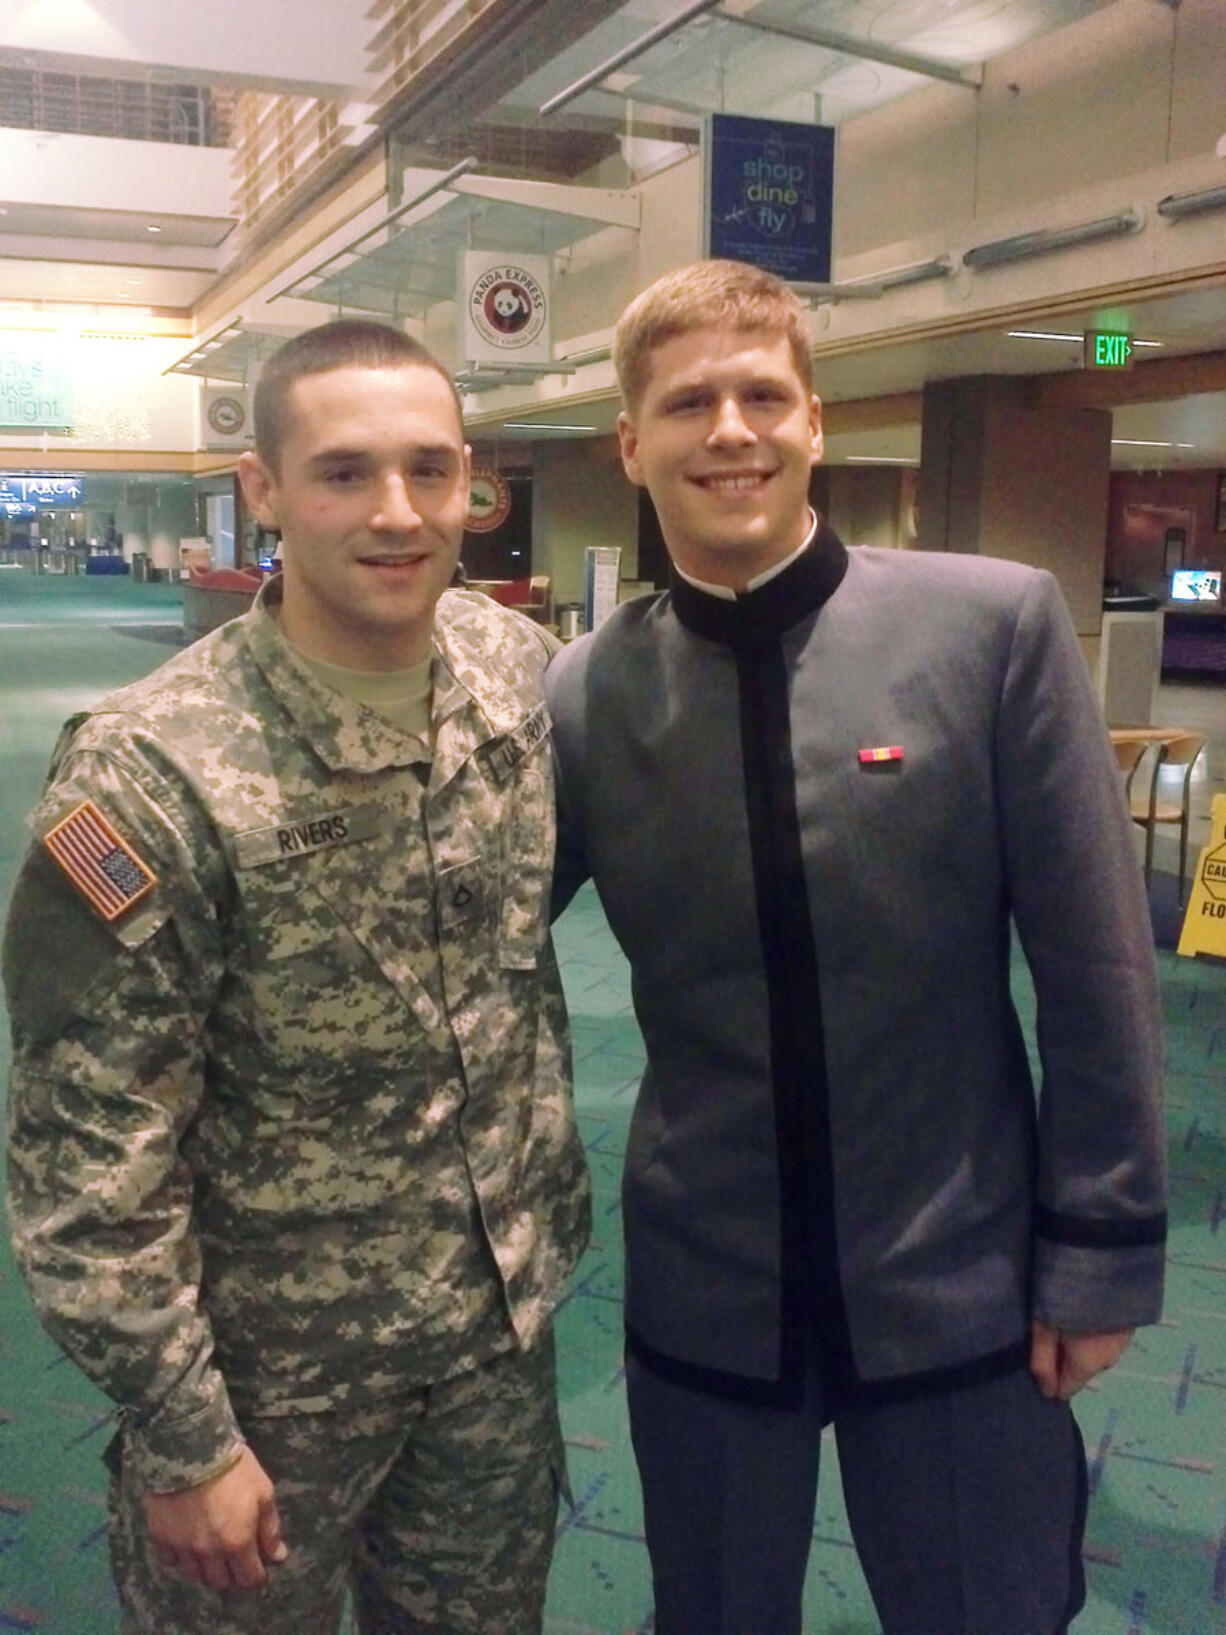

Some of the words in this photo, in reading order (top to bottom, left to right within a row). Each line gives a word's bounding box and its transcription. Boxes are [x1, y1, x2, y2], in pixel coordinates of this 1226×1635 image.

[743, 157, 804, 187] shop
[747, 182, 798, 205] dine
[758, 207, 786, 234] fly
[473, 270, 502, 305] PANDA
[506, 269, 543, 309] EXPRESS
[1096, 335, 1128, 365] EXIT
[7, 395, 60, 421] flight
[277, 816, 348, 853] RIVERS
